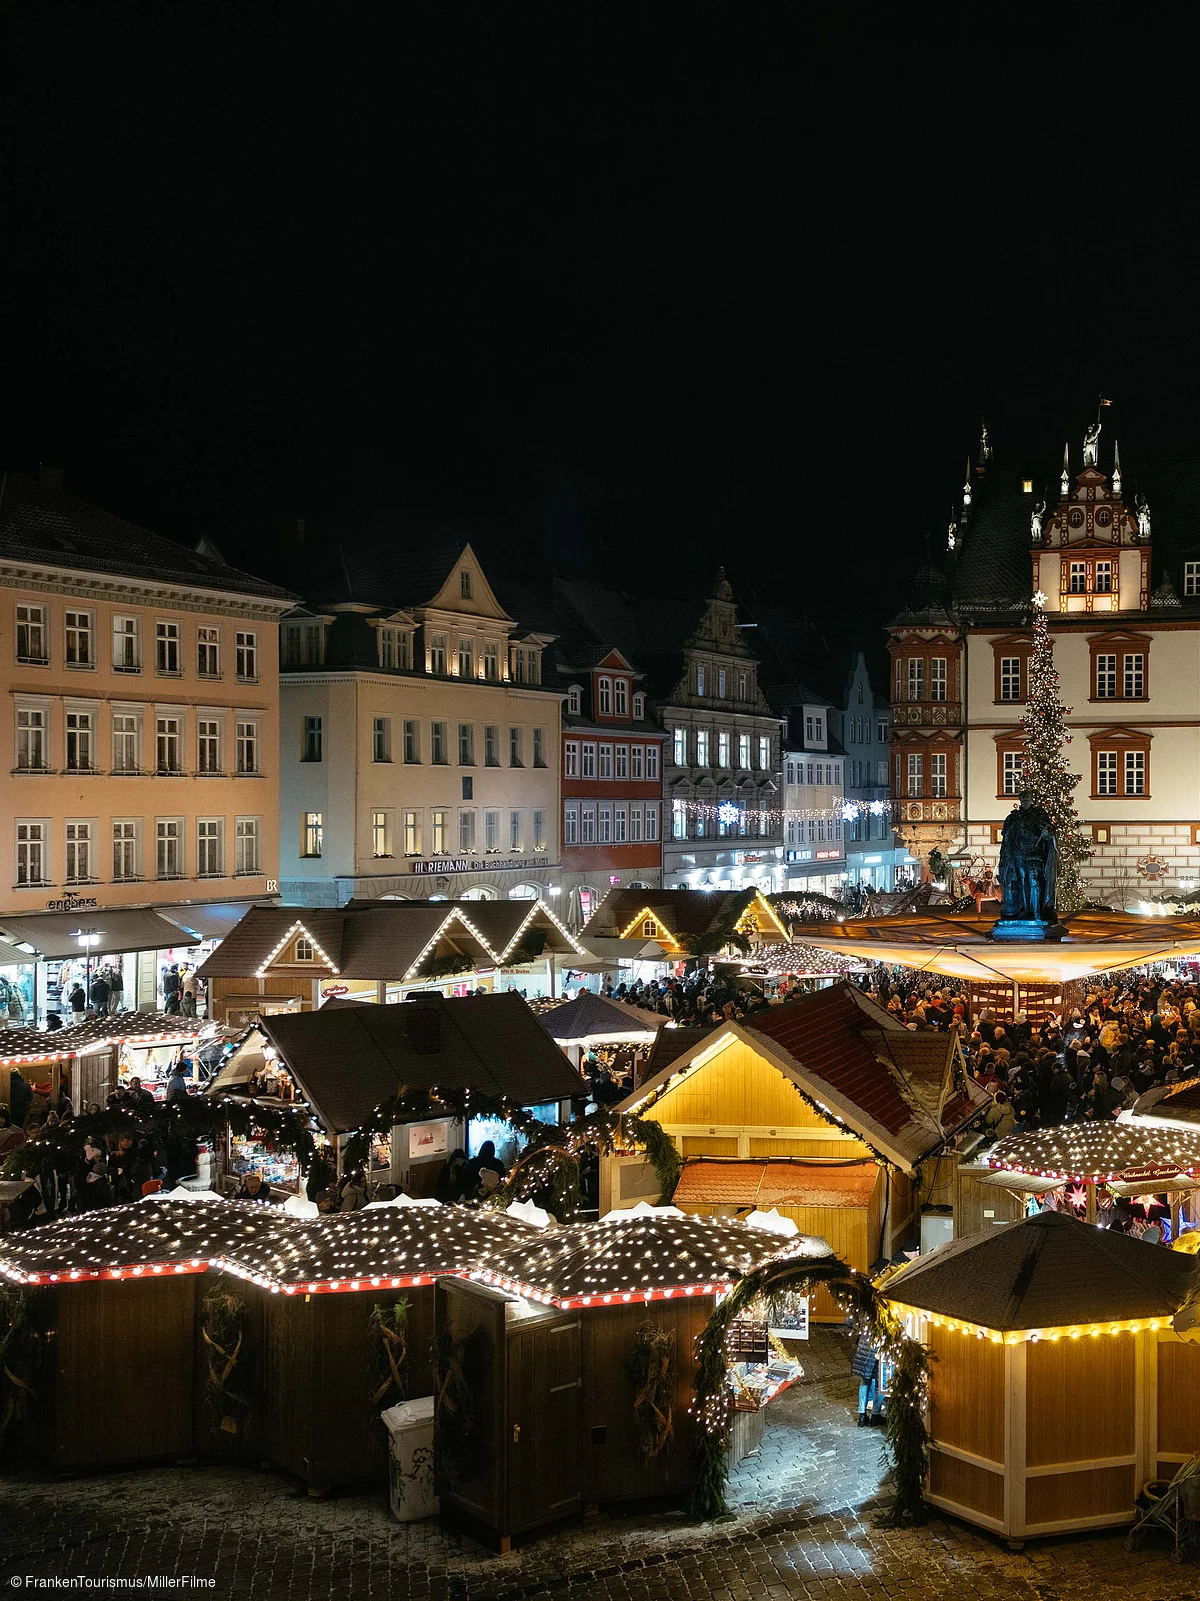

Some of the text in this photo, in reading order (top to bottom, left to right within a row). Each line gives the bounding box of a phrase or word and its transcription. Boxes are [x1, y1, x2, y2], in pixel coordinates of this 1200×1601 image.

[428, 860, 468, 873] RIEMANN
[485, 859, 525, 869] Buchhandlung
[48, 896, 97, 912] engbers
